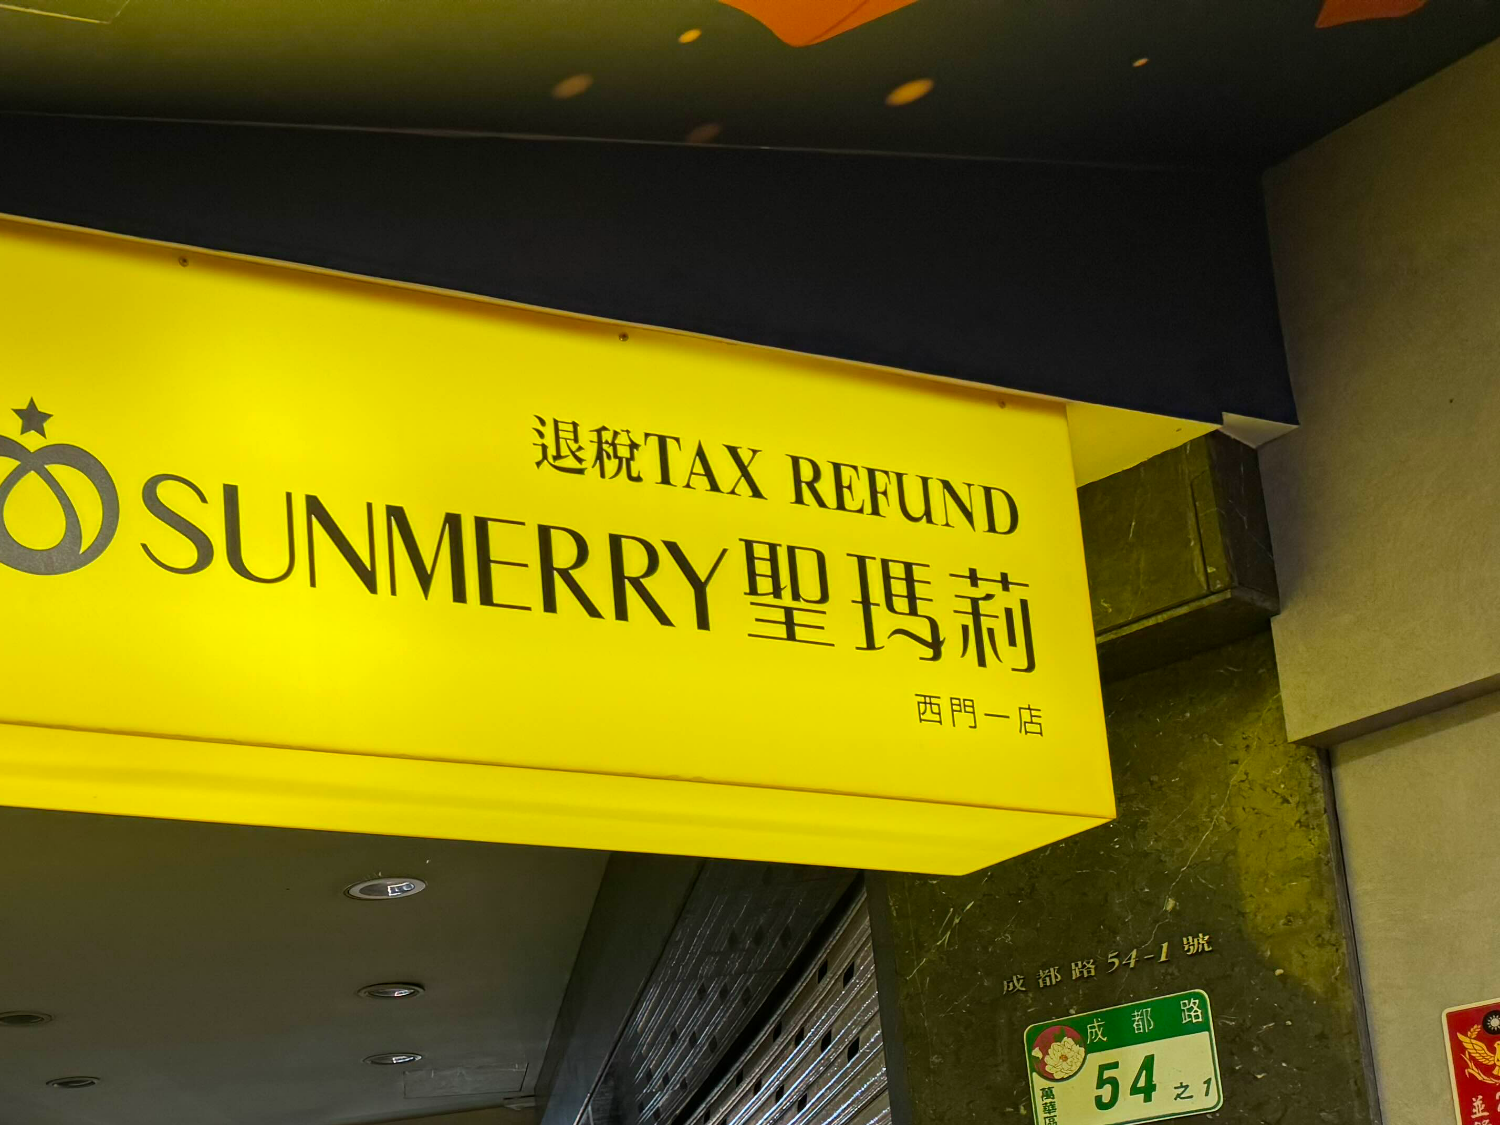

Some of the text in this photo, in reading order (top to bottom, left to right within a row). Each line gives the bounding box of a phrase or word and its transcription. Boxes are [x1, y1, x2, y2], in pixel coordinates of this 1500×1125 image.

[785, 453, 1020, 536] REFUND
[140, 473, 1037, 674] SUNMERRY 聖瑪莉
[913, 692, 1045, 738] 西門一店
[1086, 997, 1204, 1045] 成都路
[1093, 1053, 1157, 1112] 54
